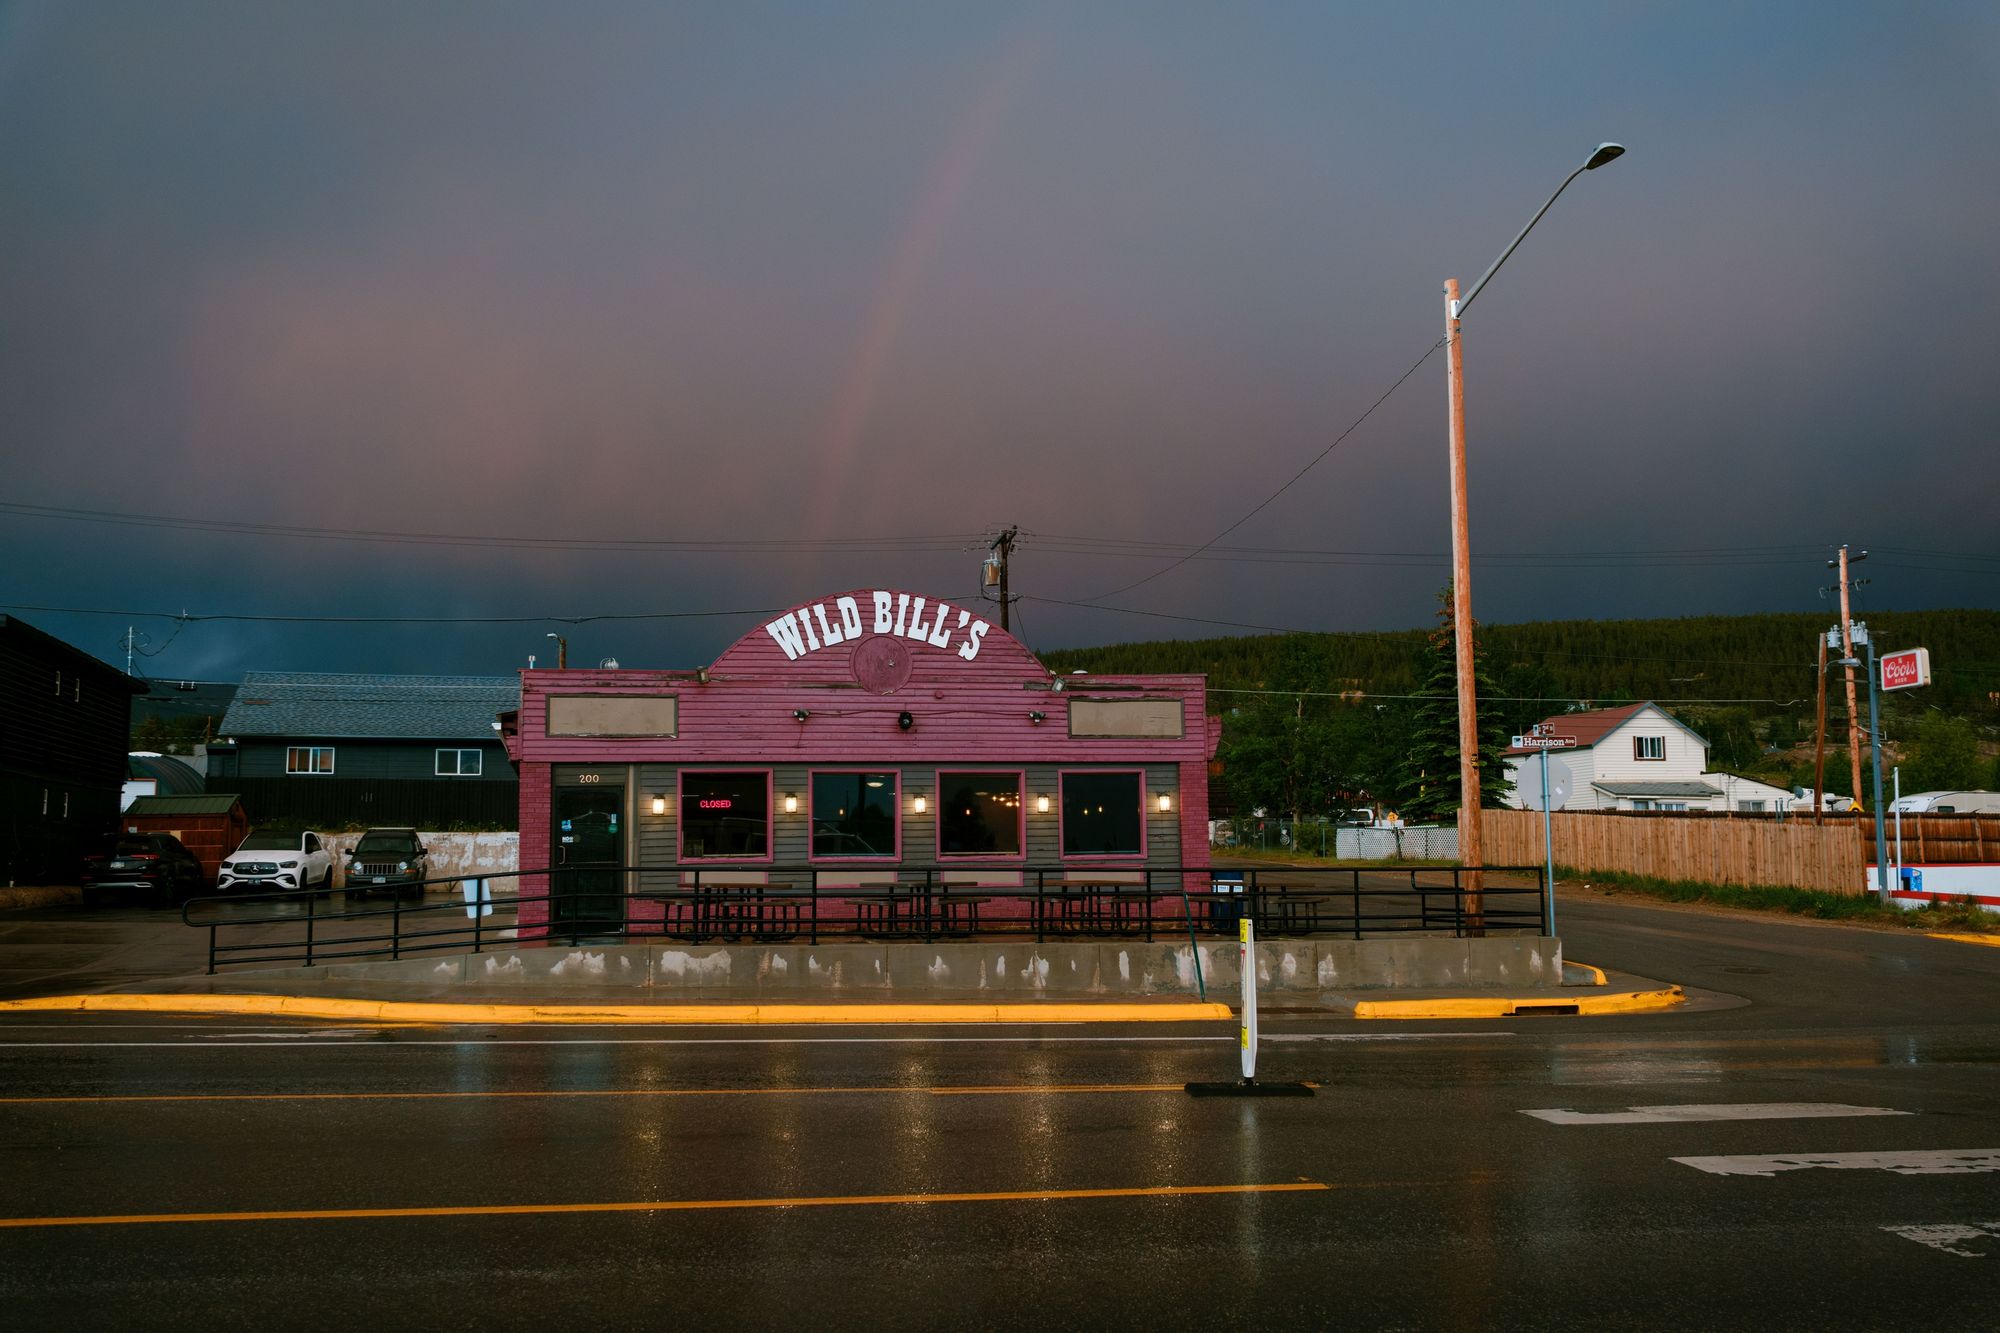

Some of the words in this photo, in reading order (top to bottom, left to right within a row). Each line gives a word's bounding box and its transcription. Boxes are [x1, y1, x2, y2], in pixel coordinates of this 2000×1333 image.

[765, 596, 863, 661] WILD
[873, 591, 990, 661] BILL'S
[1523, 737, 1565, 746] Harrison
[579, 774, 600, 783] 200
[700, 800, 732, 808] CLOSED
